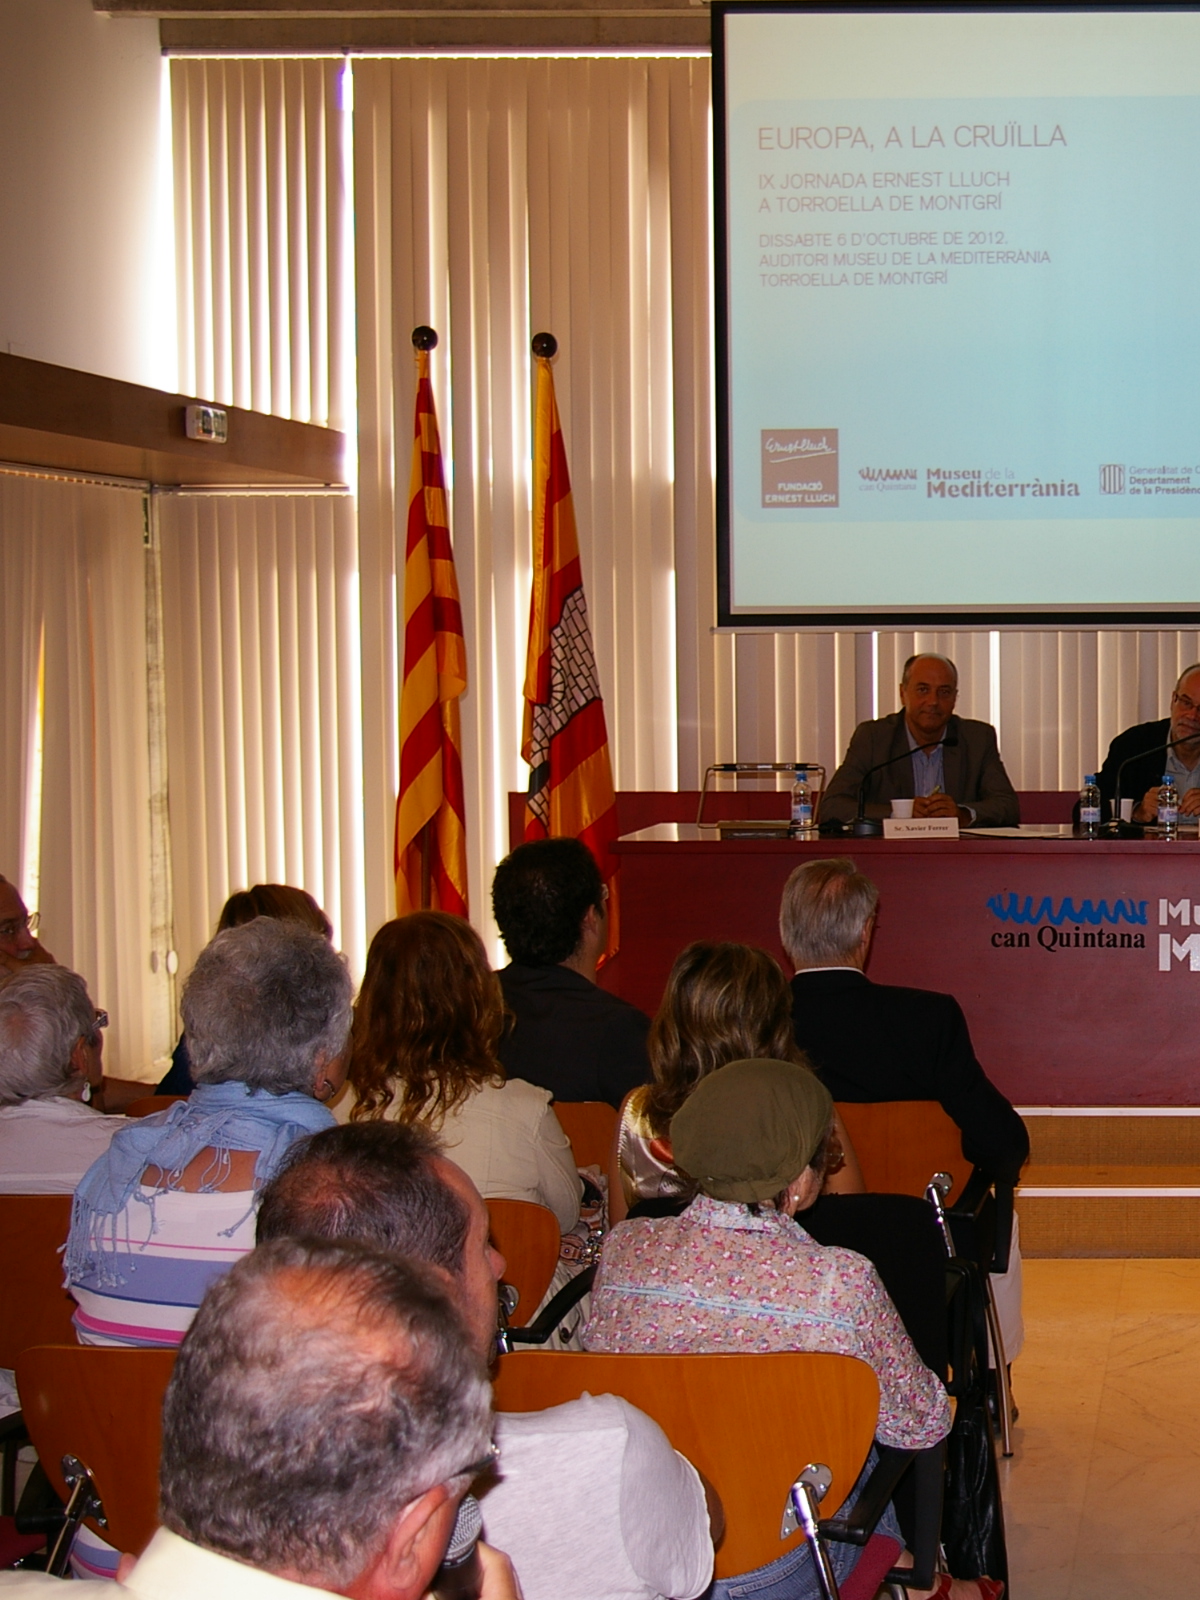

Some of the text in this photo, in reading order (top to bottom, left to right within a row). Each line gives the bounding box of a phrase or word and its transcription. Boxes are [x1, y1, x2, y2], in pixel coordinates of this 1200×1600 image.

[758, 121, 1067, 152] EUROPA, A LA CRUÏLLA
[758, 171, 1010, 190] IX JORNADA ERNEST LLUCH
[758, 192, 1002, 213] A TORROELLA DE MONTGRÍ
[759, 231, 1008, 247] DISSABTE 6 D'OCTUBRE DE 2012.
[759, 249, 1051, 268] AUDITORI MUSEU DE LA MEDITERRÀNIA
[760, 270, 948, 287] TORROELLA DE MONTGRÍ
[926, 467, 1015, 480] Museu de la
[1129, 466, 1178, 475] Generalitat
[1181, 466, 1193, 475] de
[778, 481, 823, 491] FUNDACIÓ
[927, 478, 1080, 498] Mediterrània
[1129, 476, 1190, 486] Departament
[765, 494, 836, 503] ERNEST LLUCH
[1129, 486, 1141, 495] de
[1144, 486, 1152, 495] la
[990, 926, 1146, 952] can Quintana
